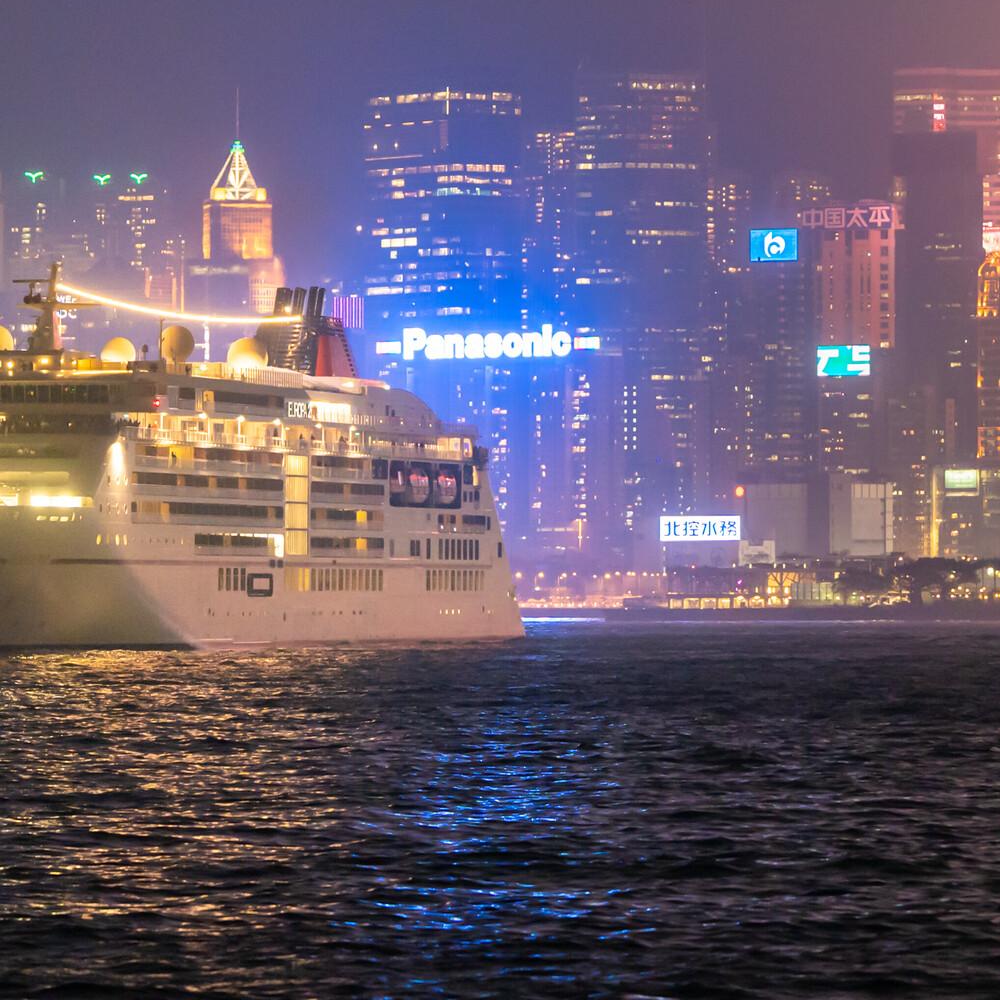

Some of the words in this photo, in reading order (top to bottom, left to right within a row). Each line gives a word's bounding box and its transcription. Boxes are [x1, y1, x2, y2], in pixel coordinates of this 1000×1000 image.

[802, 206, 891, 229] 中国太平
[402, 323, 572, 360] Panasonic
[663, 520, 738, 537] 北控水務
